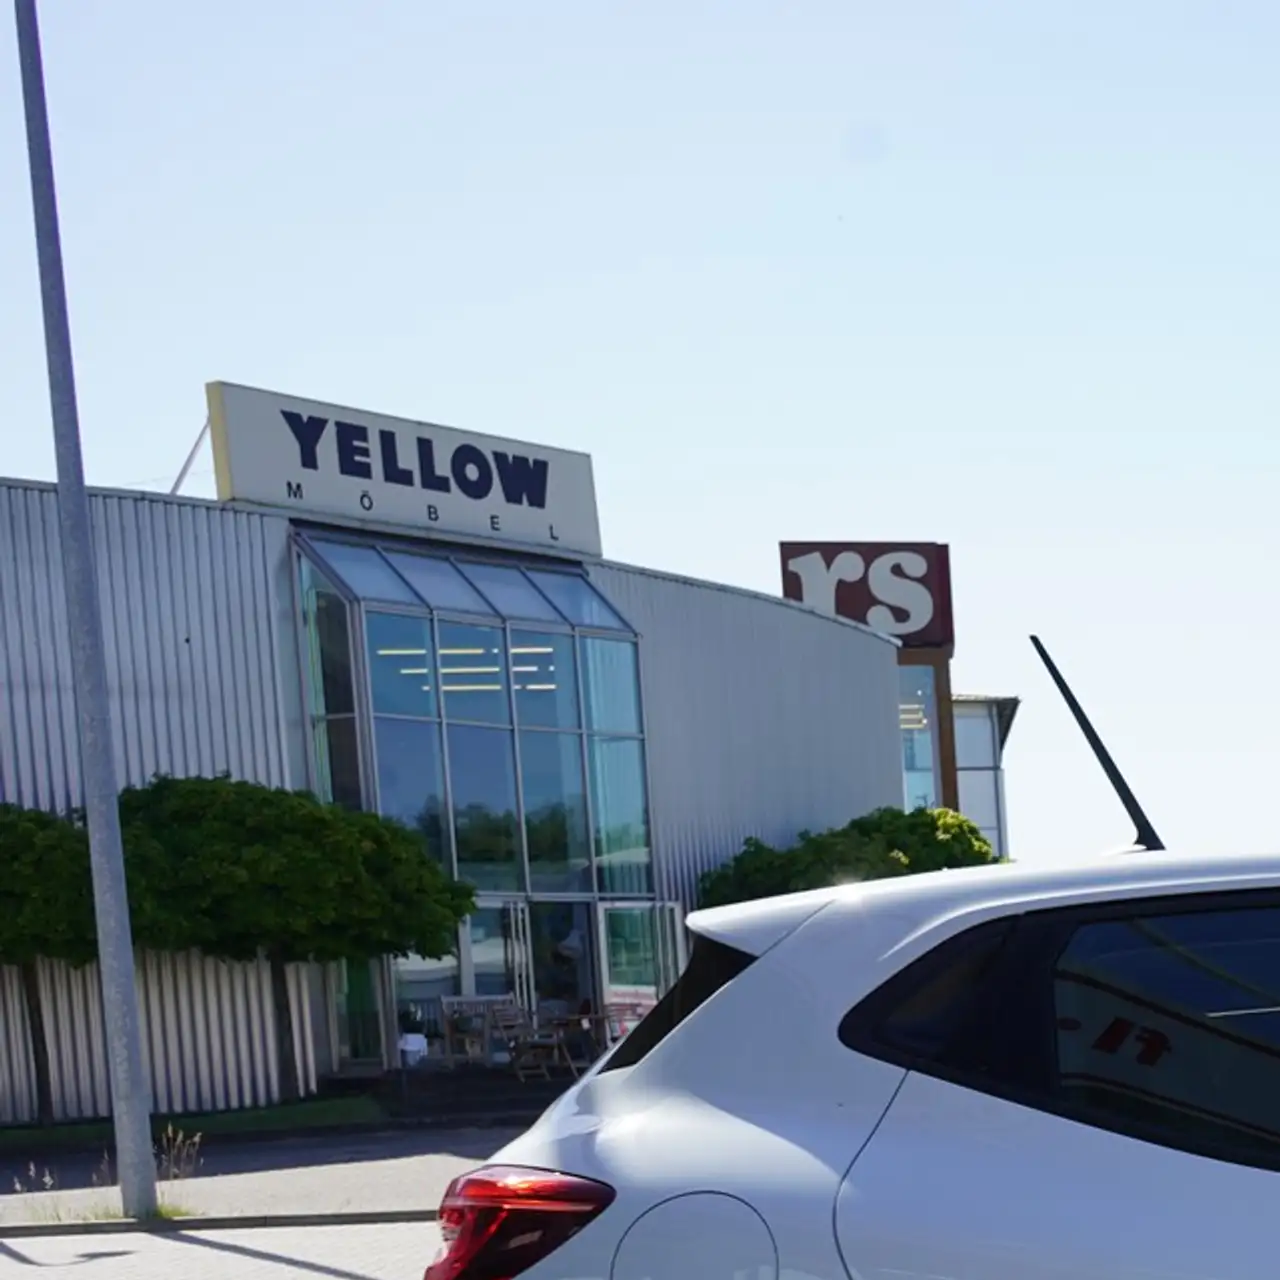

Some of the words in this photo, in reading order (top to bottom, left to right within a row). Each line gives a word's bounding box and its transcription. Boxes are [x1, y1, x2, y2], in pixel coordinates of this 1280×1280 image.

[280, 409, 549, 509] YELLOW
[286, 481, 559, 541] MÖBEL
[788, 550, 934, 635] rs
